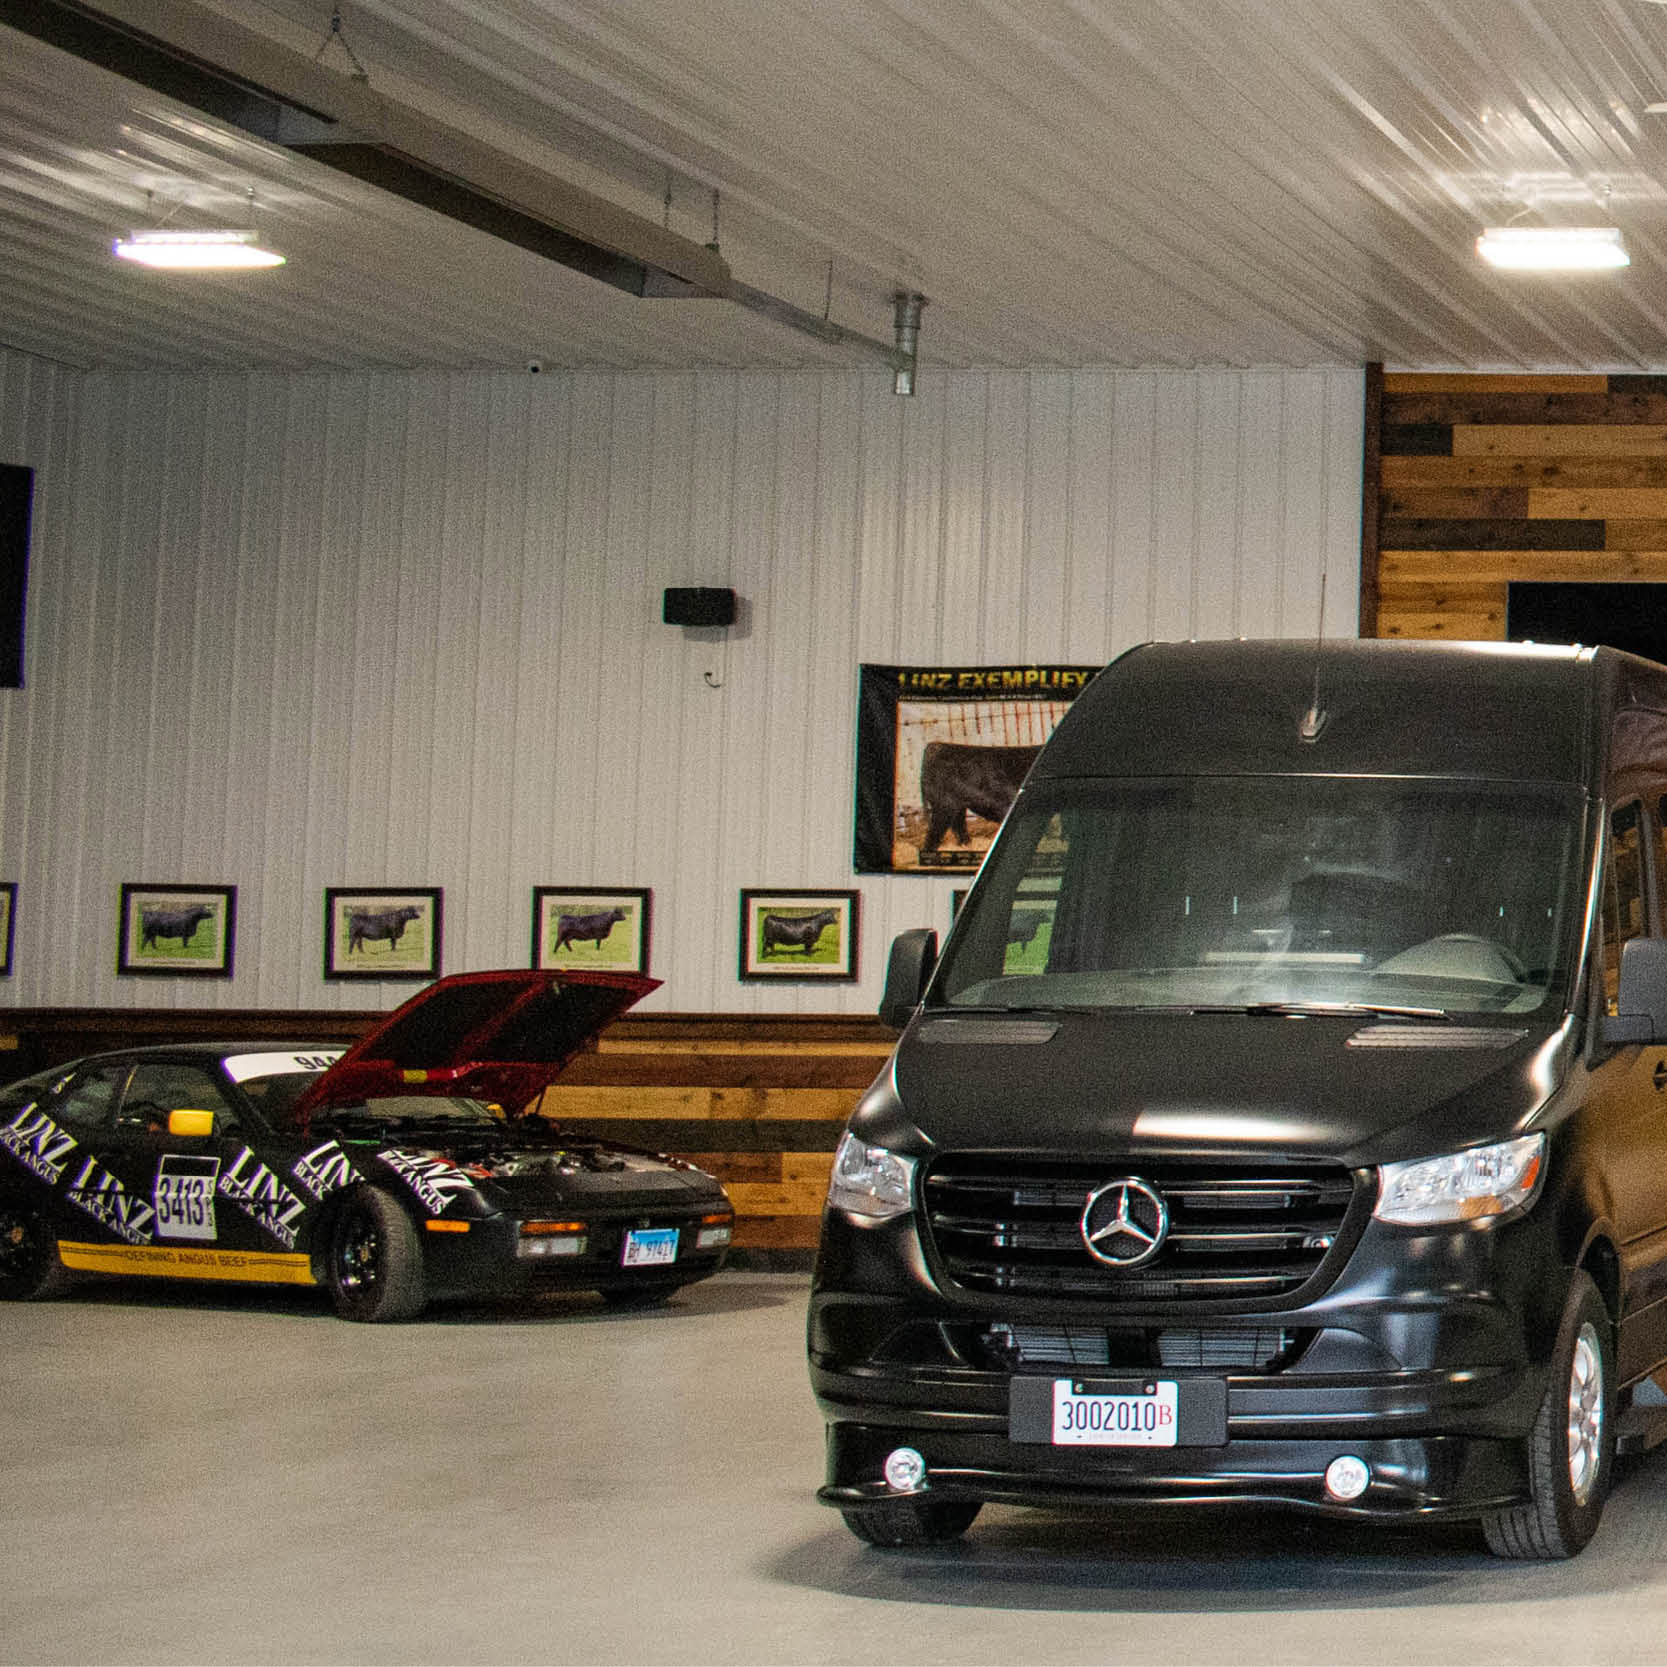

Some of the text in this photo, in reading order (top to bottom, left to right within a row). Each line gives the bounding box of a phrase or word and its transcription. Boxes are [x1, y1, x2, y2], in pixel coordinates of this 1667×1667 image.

[900, 670, 1088, 688] LINZ EXEMPLIFY
[9, 1101, 79, 1173] LINZ
[228, 1145, 306, 1237] LINZ
[302, 1139, 366, 1191] LIN
[74, 1154, 156, 1241] LINZ
[159, 1177, 205, 1226] 3413
[1062, 1400, 1172, 1431] 3002010 B
